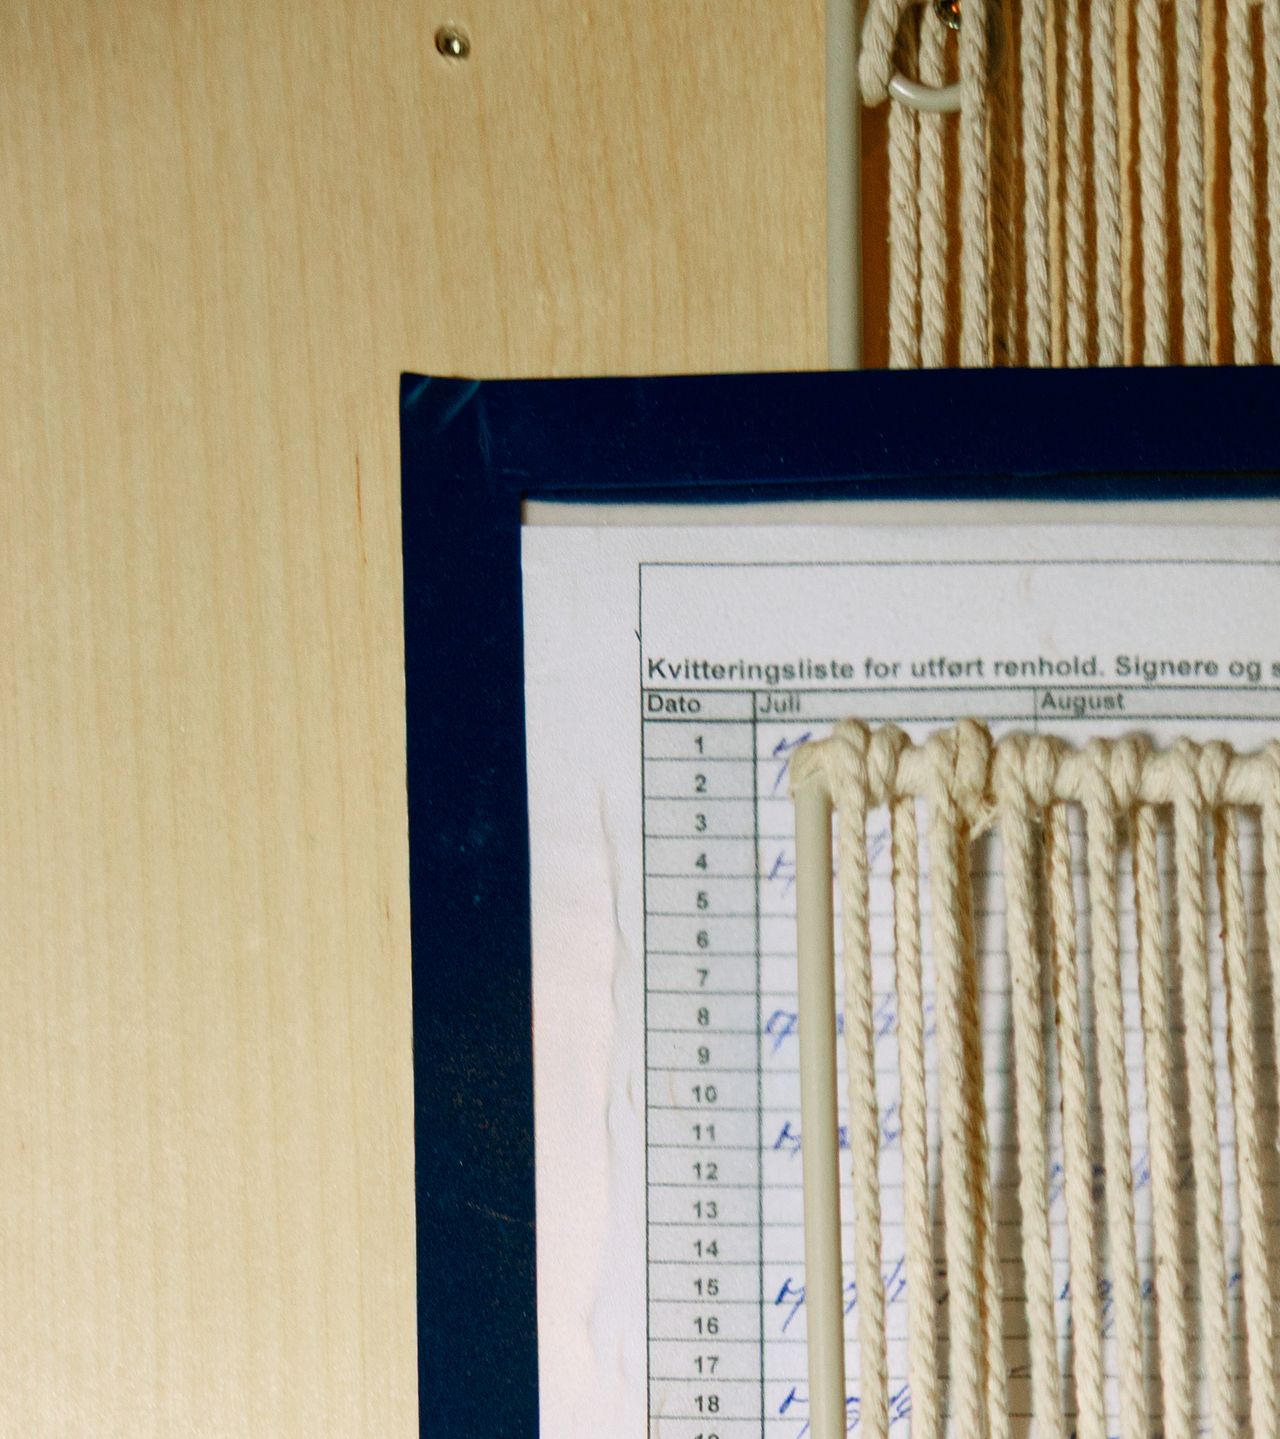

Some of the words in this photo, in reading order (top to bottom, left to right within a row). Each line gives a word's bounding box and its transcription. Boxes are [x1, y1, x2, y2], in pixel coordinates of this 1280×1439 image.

[647, 658, 854, 684] Kvitteringsliste
[864, 658, 899, 679] for
[911, 657, 984, 678] utført
[993, 655, 1105, 677] renhold.
[1115, 655, 1219, 682] Signere
[1228, 659, 1262, 683] og
[647, 694, 701, 714] Dato
[759, 692, 801, 714] Juli
[1041, 689, 1125, 714] August
[692, 733, 705, 754] 1
[693, 772, 708, 793] 2
[693, 811, 708, 832] 3
[693, 850, 708, 871] 4
[694, 889, 709, 910] 5
[695, 927, 710, 948] 6
[695, 966, 710, 987] 7
[695, 1005, 710, 1026] 8
[696, 1044, 711, 1065] 9
[691, 1083, 718, 1104] 10
[691, 1122, 716, 1143] 11
[691, 1161, 718, 1182] 12
[692, 1199, 719, 1220] 13
[692, 1238, 719, 1259] 14
[692, 1277, 719, 1298] 15
[693, 1316, 720, 1337] 16
[693, 1355, 720, 1376] 17
[693, 1393, 720, 1414] 18
